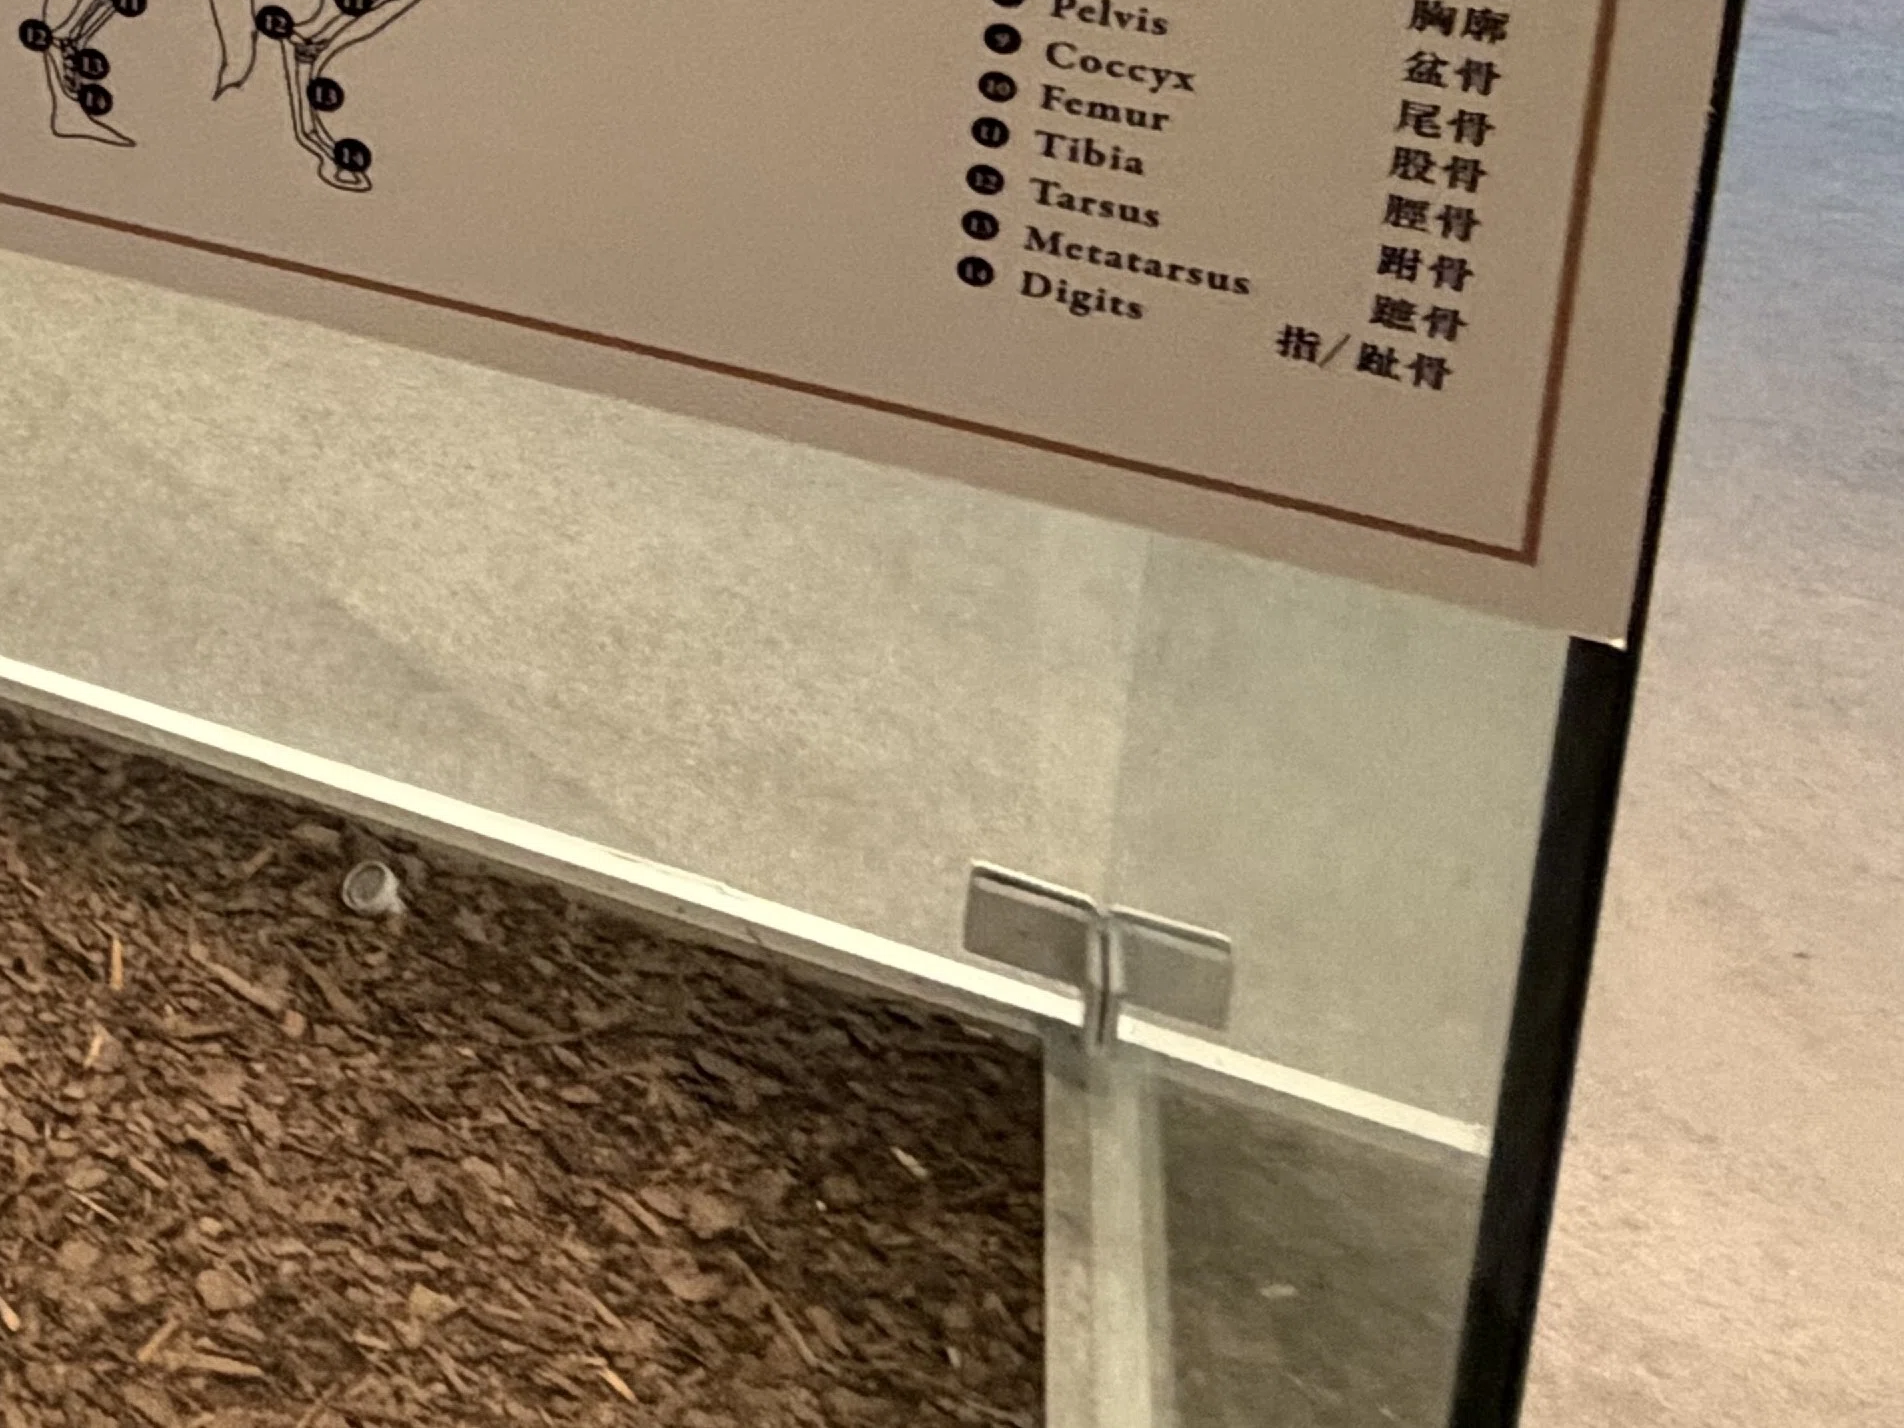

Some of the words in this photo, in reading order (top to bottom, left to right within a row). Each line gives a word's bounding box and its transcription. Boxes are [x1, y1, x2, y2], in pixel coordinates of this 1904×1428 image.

[1043, 39, 1196, 96] Coccyx
[1401, 48, 1504, 98] 盆骨
[1039, 82, 1171, 133] Femur
[1393, 97, 1498, 150] 尾骨
[1032, 127, 1146, 177] Tibia
[1387, 144, 1490, 196] 股骨
[1028, 176, 1162, 230] Tarsus
[1022, 224, 1251, 297] Metatarsus
[1019, 269, 1145, 322] Digits
